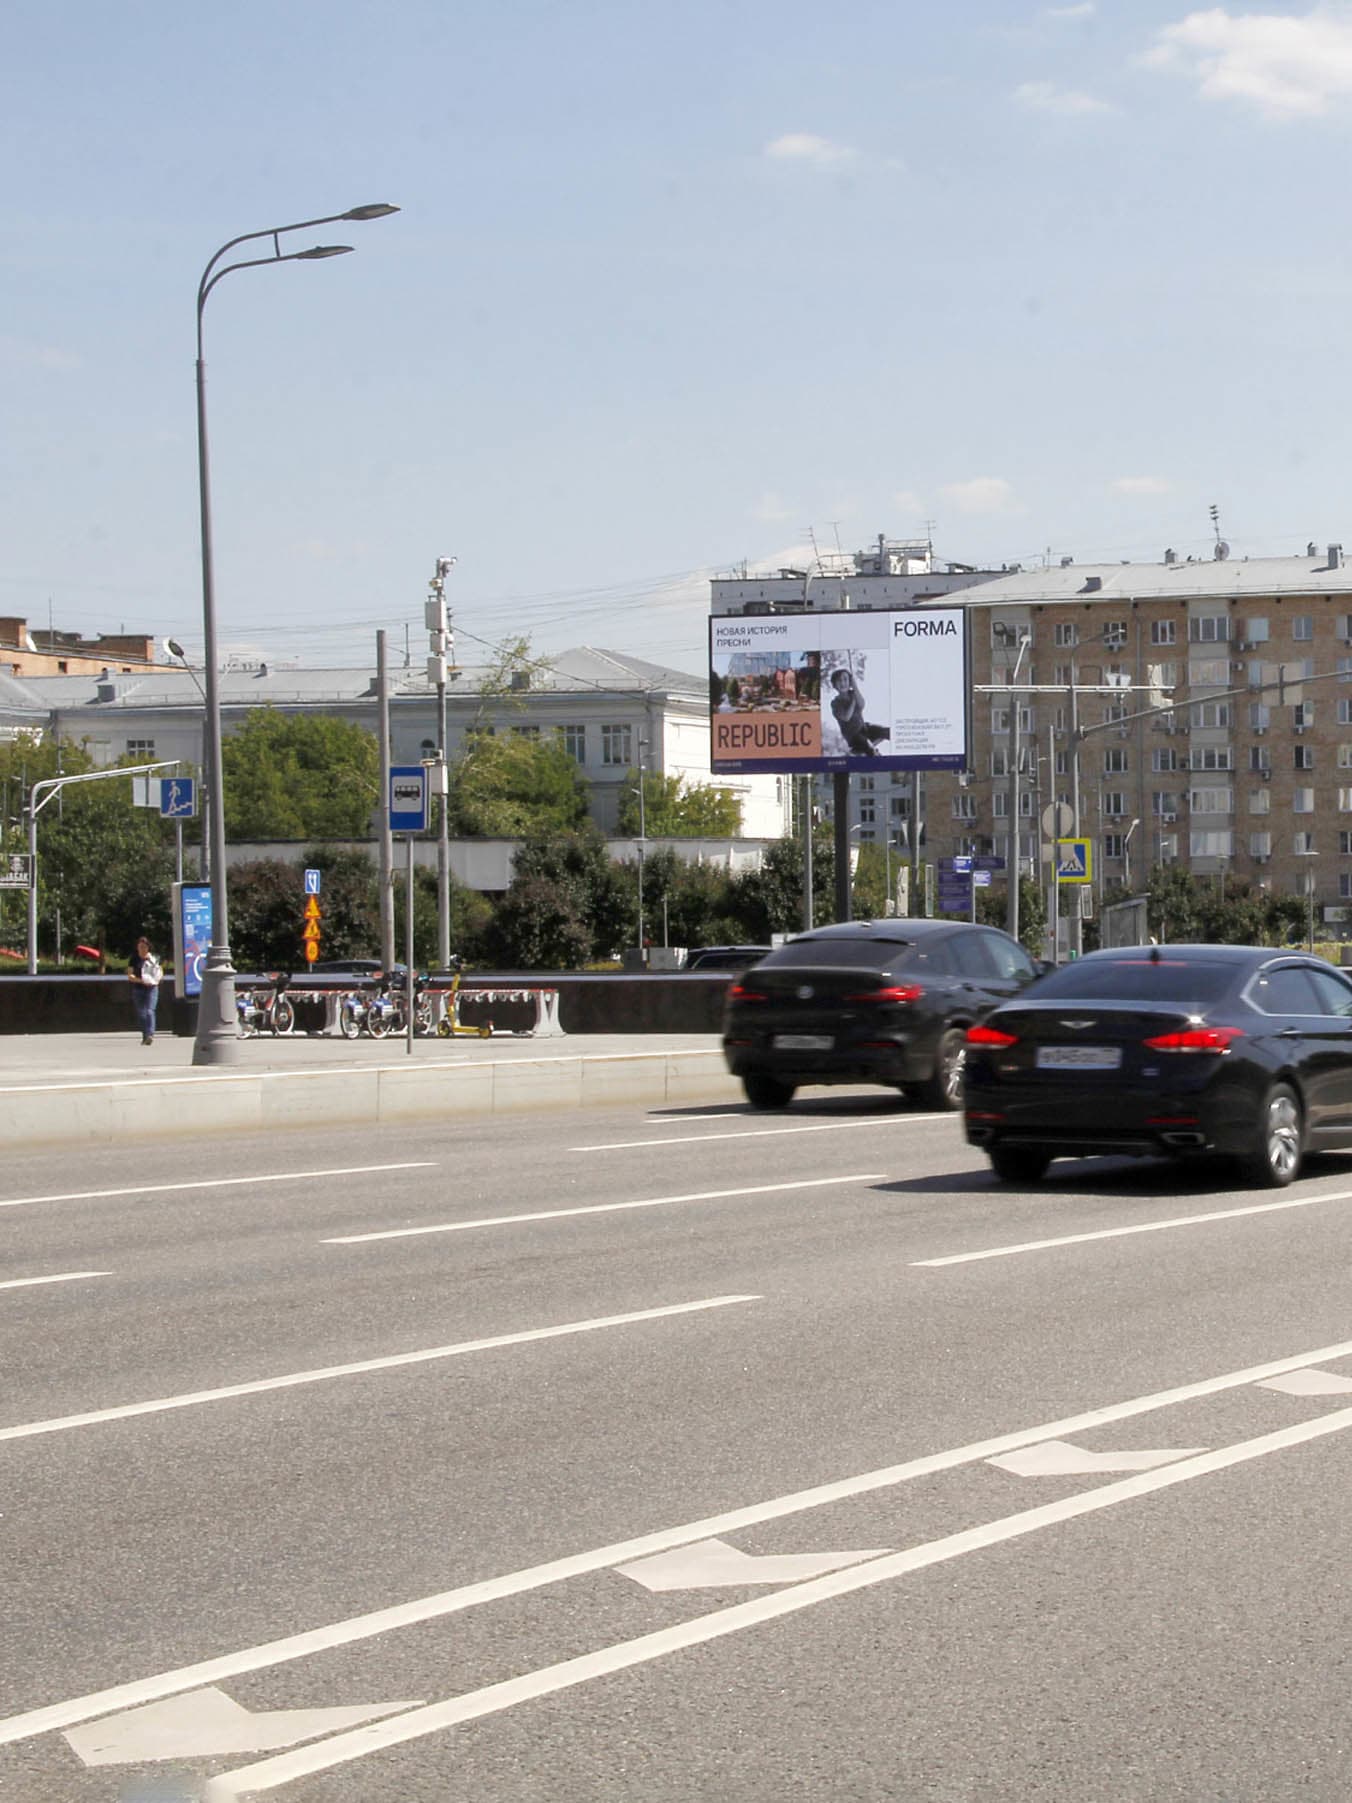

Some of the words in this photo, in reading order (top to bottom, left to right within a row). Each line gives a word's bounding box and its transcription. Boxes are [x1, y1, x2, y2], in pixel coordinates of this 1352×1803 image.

[716, 626, 746, 636] НОВАЯ
[747, 625, 788, 635] ИСТОРИЯ
[894, 620, 957, 637] FORMA
[716, 638, 752, 648] ПРЕСНИ
[718, 722, 812, 748] REPUBLIC
